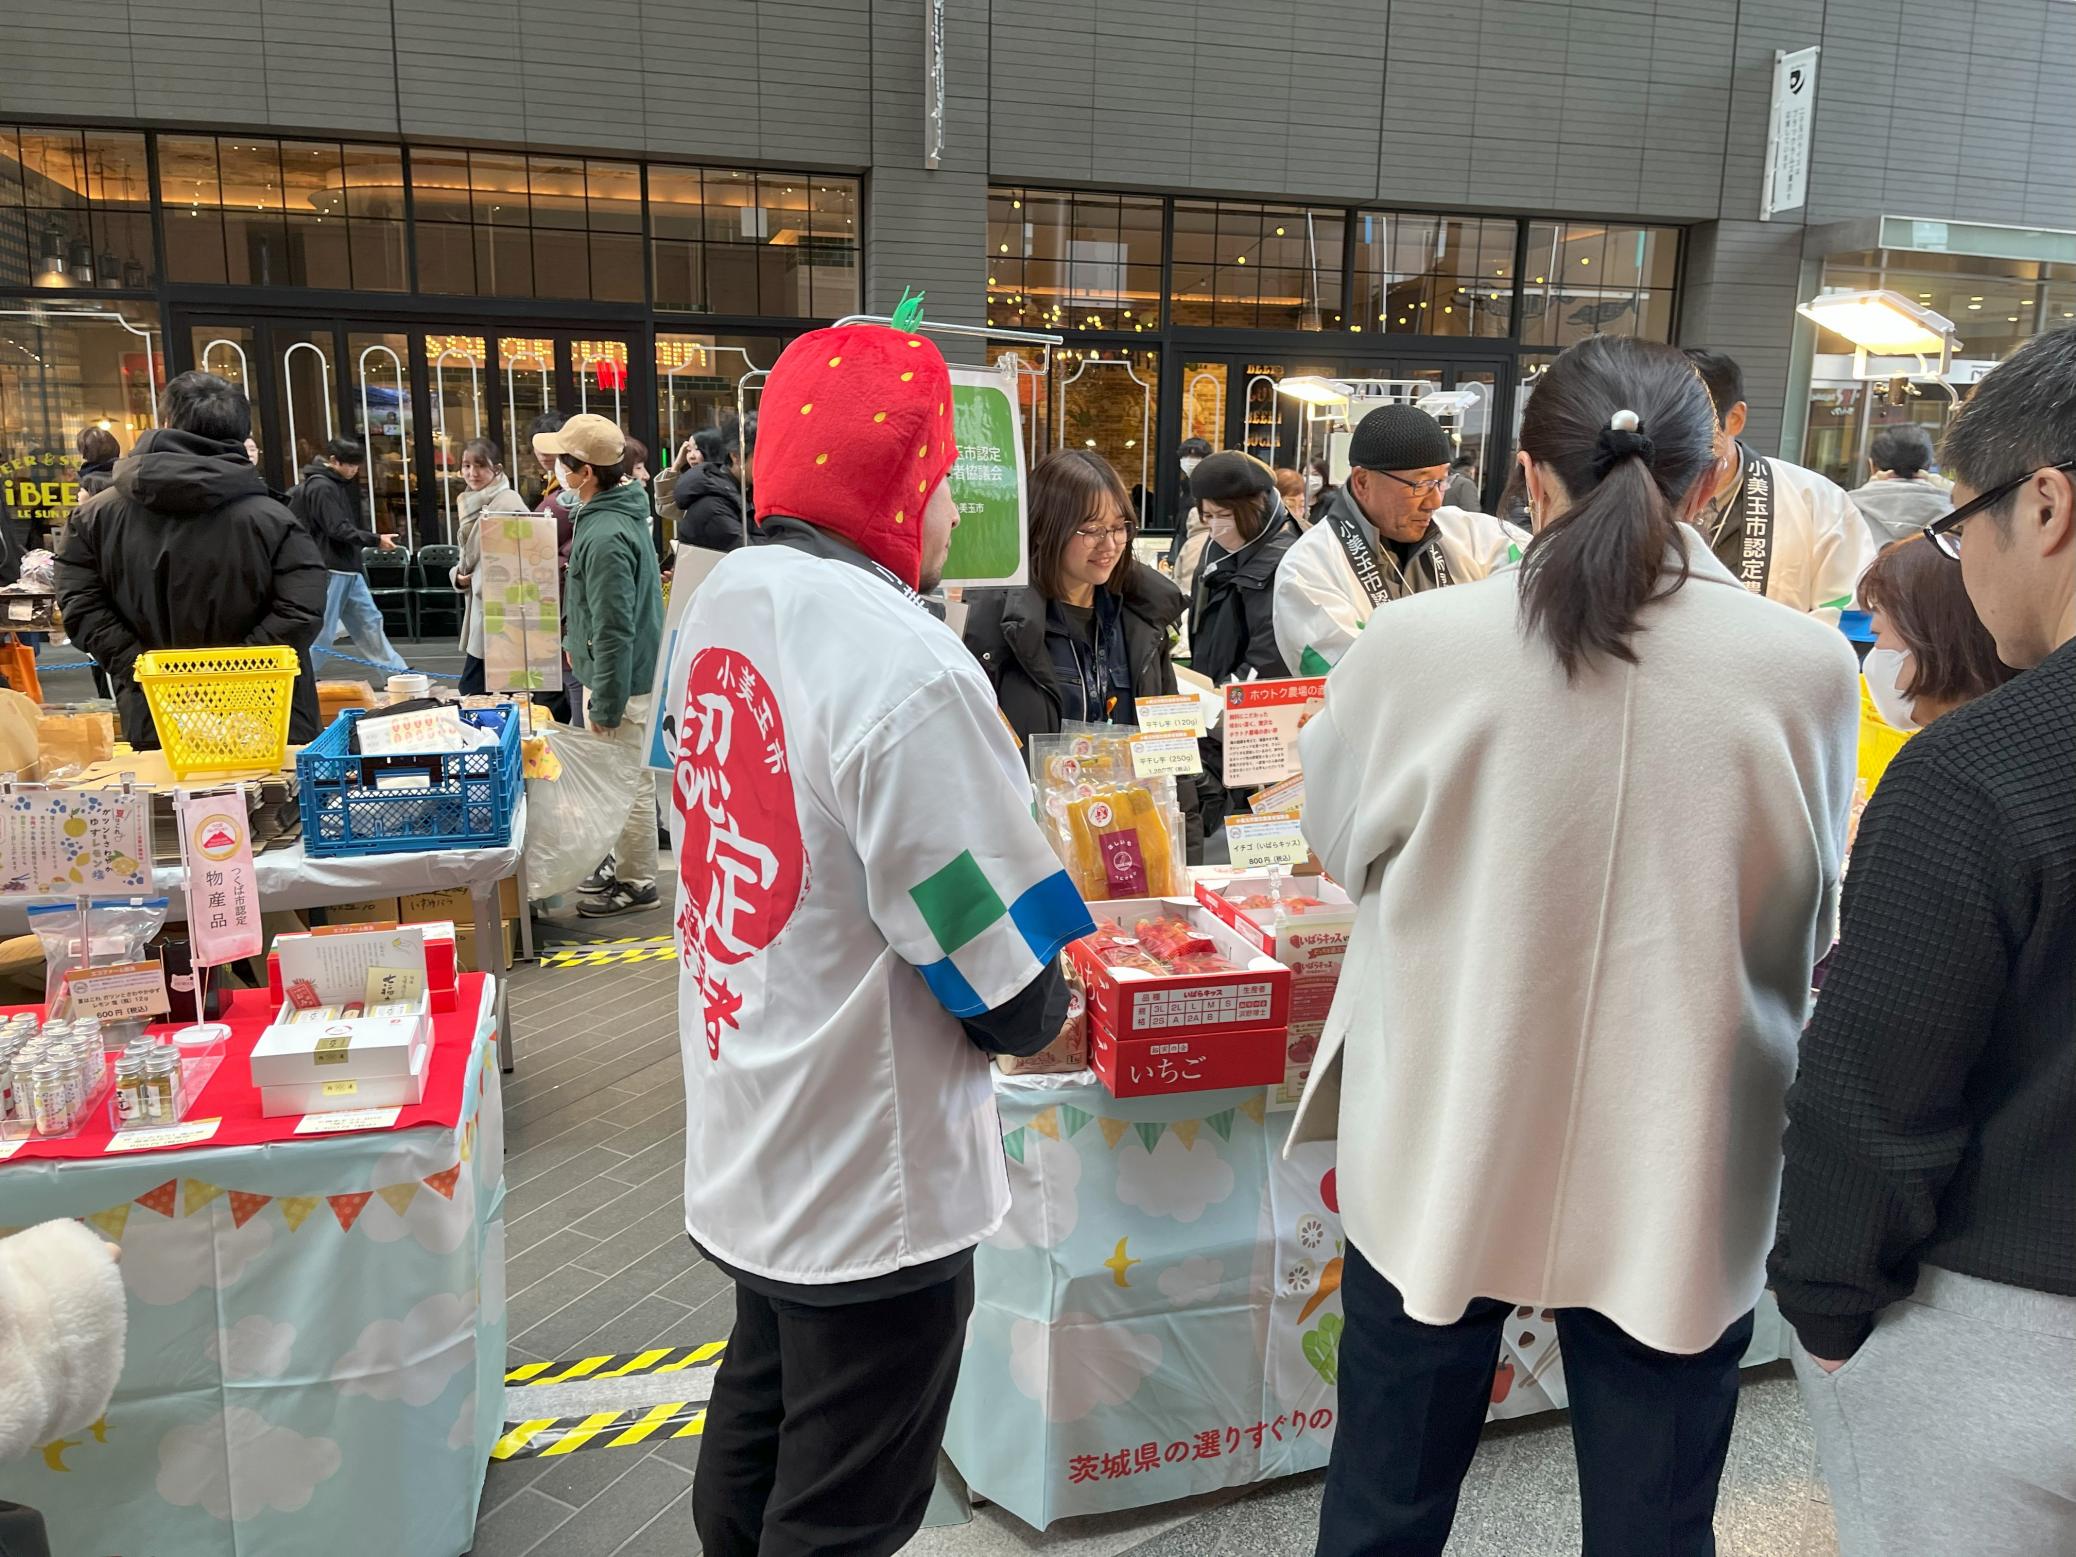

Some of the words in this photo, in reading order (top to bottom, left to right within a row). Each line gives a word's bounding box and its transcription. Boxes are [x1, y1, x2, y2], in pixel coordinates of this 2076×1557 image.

[17, 509, 32, 519] LE
[717, 655, 787, 775] 小美玉市
[676, 693, 780, 962] 認定
[206, 869, 227, 930] 物産品
[231, 866, 248, 927] つくば市認定
[1154, 1004, 1165, 1013] 3L
[1170, 1003, 1182, 1012] 2L
[1191, 1001, 1197, 1010] L
[1207, 1001, 1215, 1009] M
[1225, 1000, 1232, 1008] S
[1183, 989, 1223, 999] いばらキッス
[1152, 1017, 1165, 1025] 2S
[1172, 1016, 1179, 1024] A
[1187, 1014, 1200, 1023] 2A
[1207, 1013, 1213, 1021] B
[1130, 1055, 1207, 1084] いちご
[1068, 1408, 1333, 1485] 茨城県の選りすぐりの
